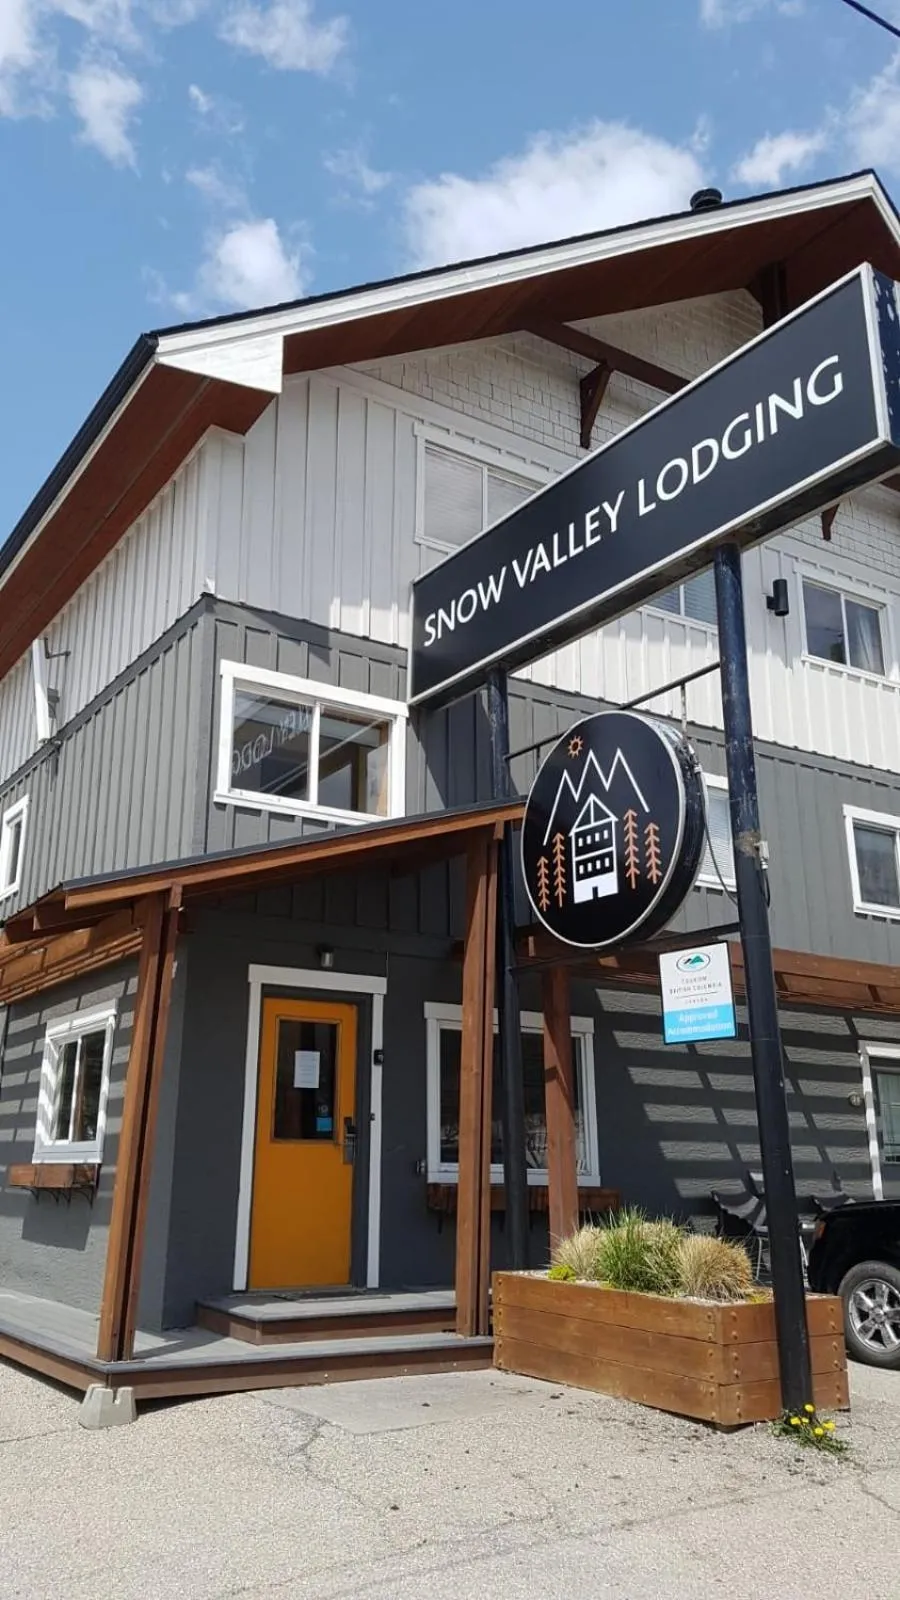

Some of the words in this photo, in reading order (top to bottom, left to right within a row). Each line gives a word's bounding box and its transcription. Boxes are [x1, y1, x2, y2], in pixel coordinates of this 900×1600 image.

[423, 566, 507, 647] SNOW
[511, 490, 625, 588] VALLEY
[637, 354, 844, 517] LODGING
[679, 1009, 718, 1023] Approved
